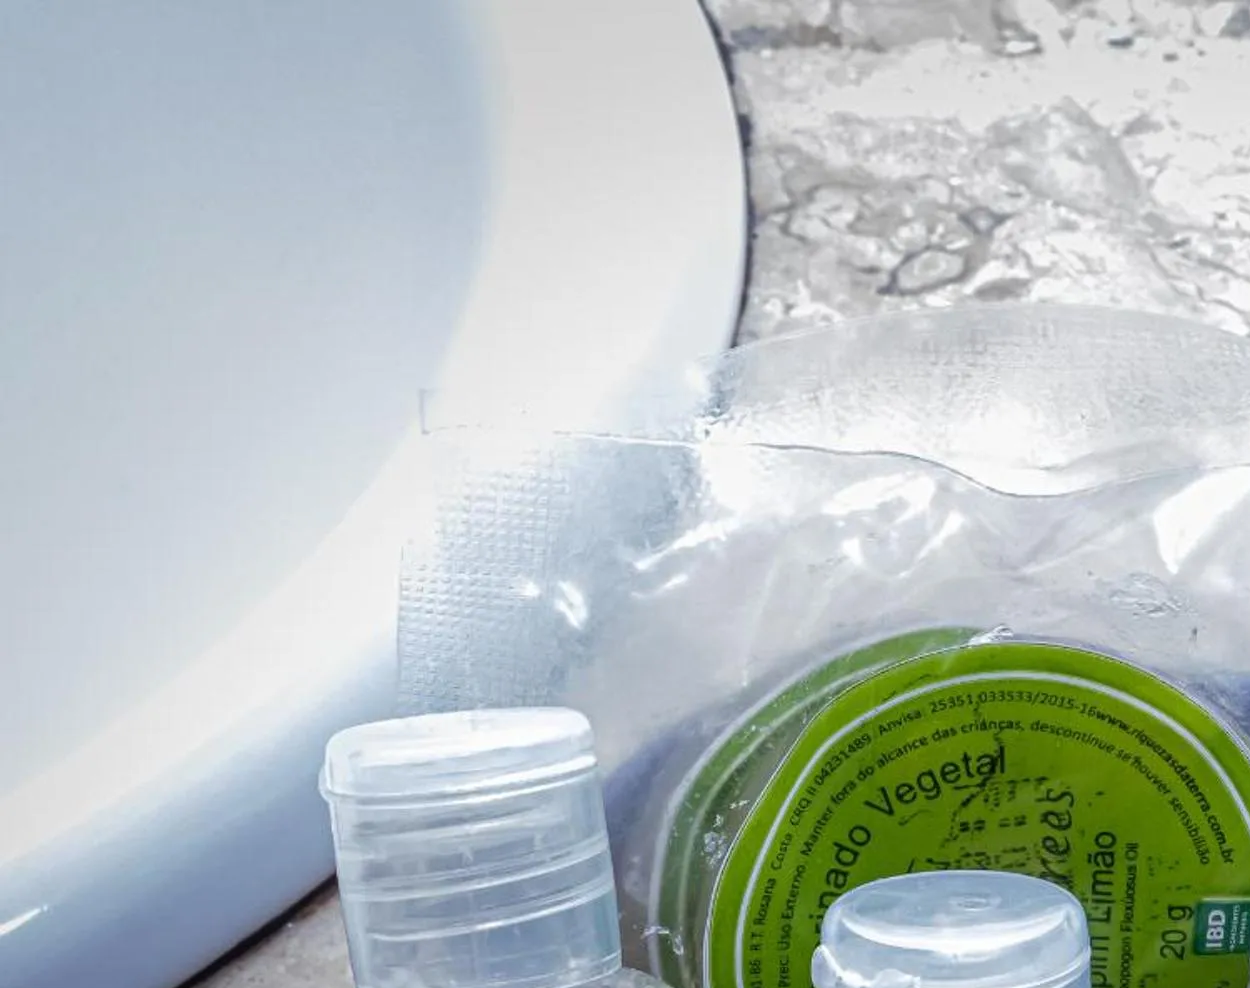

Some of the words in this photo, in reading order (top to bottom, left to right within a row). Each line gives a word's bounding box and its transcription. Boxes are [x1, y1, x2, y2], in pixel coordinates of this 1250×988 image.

[771, 832, 793, 871] Costa
[878, 709, 922, 736] Anvisa
[864, 744, 1006, 817] Vegetal
[778, 923, 792, 950] Uso
[800, 806, 834, 857] Manter
[831, 780, 858, 806] fora
[857, 765, 875, 781] do
[877, 735, 929, 768] alcance
[931, 726, 957, 742] das
[1030, 719, 1115, 753] descontinue
[1115, 747, 1131, 762] se
[1125, 843, 1140, 863] Oil
[1087, 830, 1118, 924] Limão
[1168, 904, 1195, 921] g
[1206, 908, 1226, 949] IBD
[1160, 928, 1188, 961] 20
